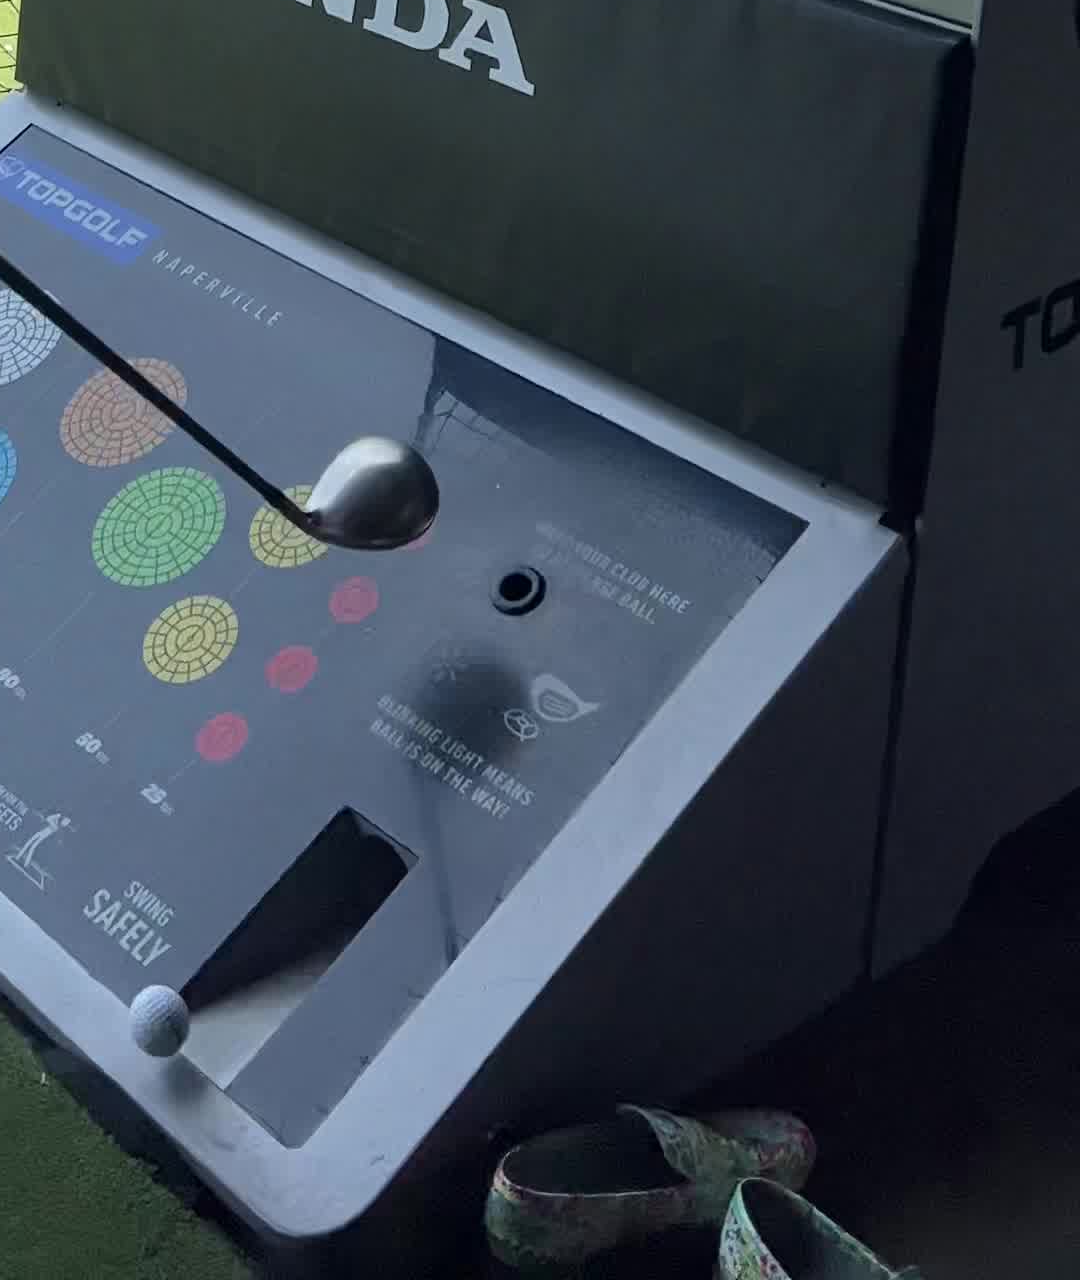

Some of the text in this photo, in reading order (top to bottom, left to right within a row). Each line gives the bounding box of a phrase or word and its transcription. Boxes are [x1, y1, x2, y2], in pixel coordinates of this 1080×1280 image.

[14, 171, 284, 328] TOPGOLF NAPERVILLE
[649, 583, 692, 615] HERE
[140, 783, 167, 805] 25
[369, 719, 404, 750] BALL
[402, 741, 422, 762] IS
[420, 755, 445, 779] ON
[442, 771, 471, 799] THE
[442, 732, 484, 770] LIGHT
[480, 760, 534, 806] MEANS
[83, 888, 173, 967] SAFELY
[123, 881, 175, 927] SWING
